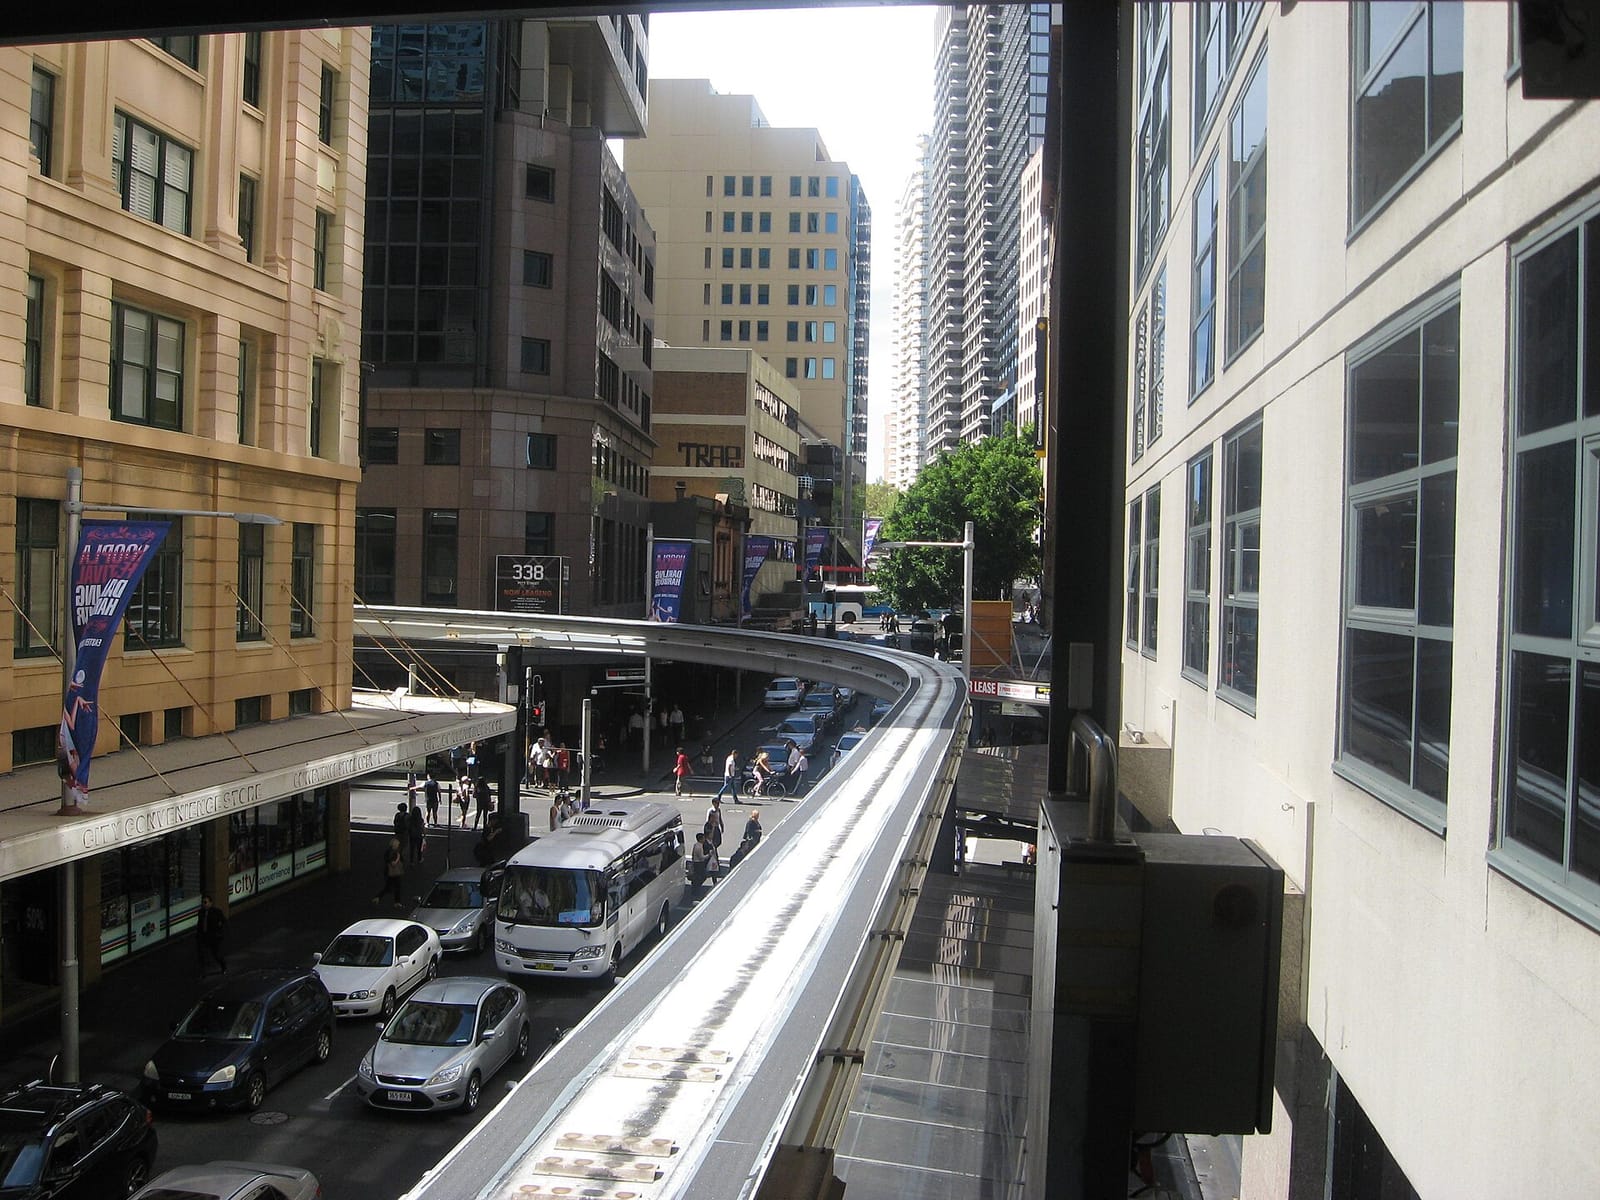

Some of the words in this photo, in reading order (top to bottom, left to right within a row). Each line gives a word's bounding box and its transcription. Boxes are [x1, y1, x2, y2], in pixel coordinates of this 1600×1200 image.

[512, 564, 544, 580] 338
[974, 681, 996, 694] LEASE
[83, 823, 121, 849] CITY
[124, 796, 220, 837] CONVENIENCE
[223, 783, 262, 809] STORE
[234, 873, 256, 894] city
